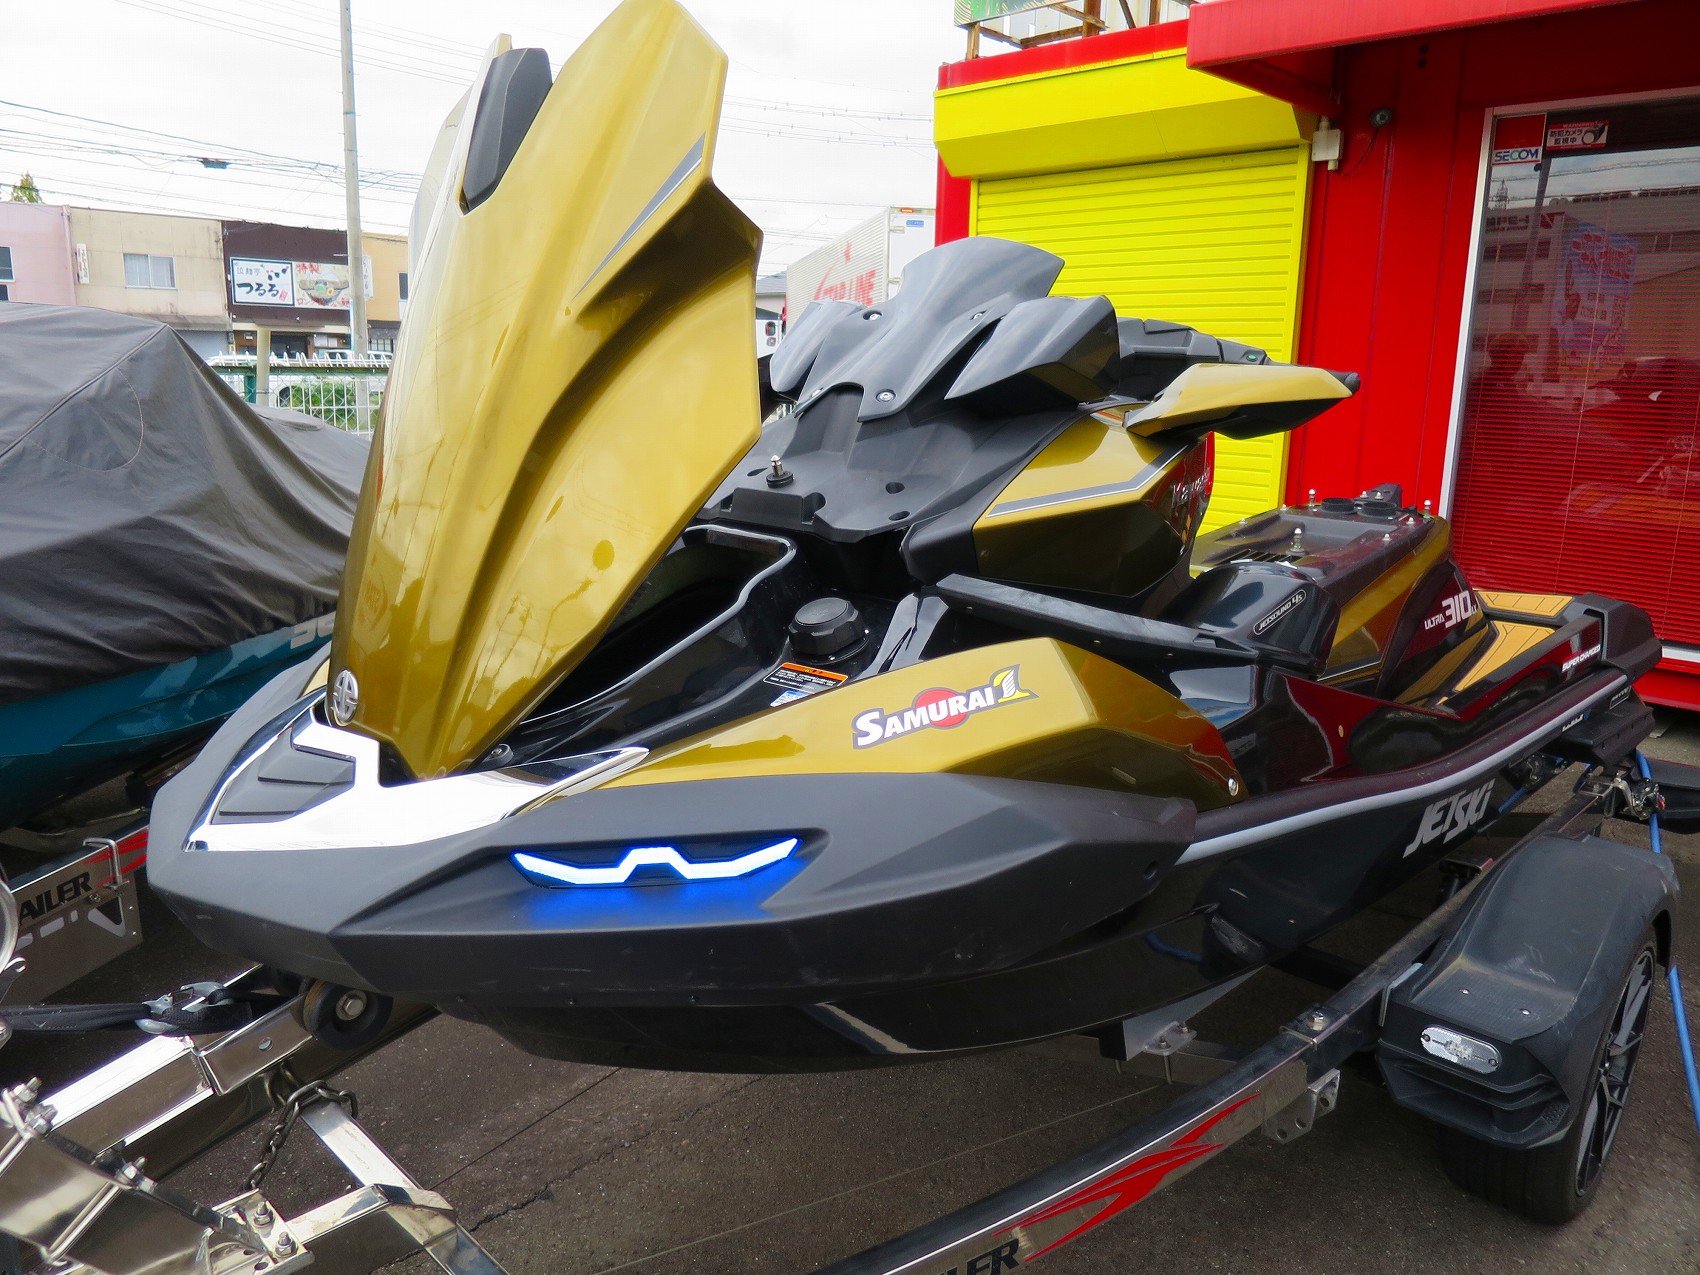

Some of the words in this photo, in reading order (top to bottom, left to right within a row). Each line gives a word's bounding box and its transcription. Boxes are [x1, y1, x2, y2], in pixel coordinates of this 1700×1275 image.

[1550, 129, 1583, 137] 防犯カメラ
[1554, 137, 1577, 145] 監視中
[1495, 149, 1539, 161] SECOM
[236, 282, 279, 298] つるる
[1424, 613, 1446, 630] ULTRA
[1561, 655, 1580, 672] SUPER
[19, 872, 92, 926] AILER
